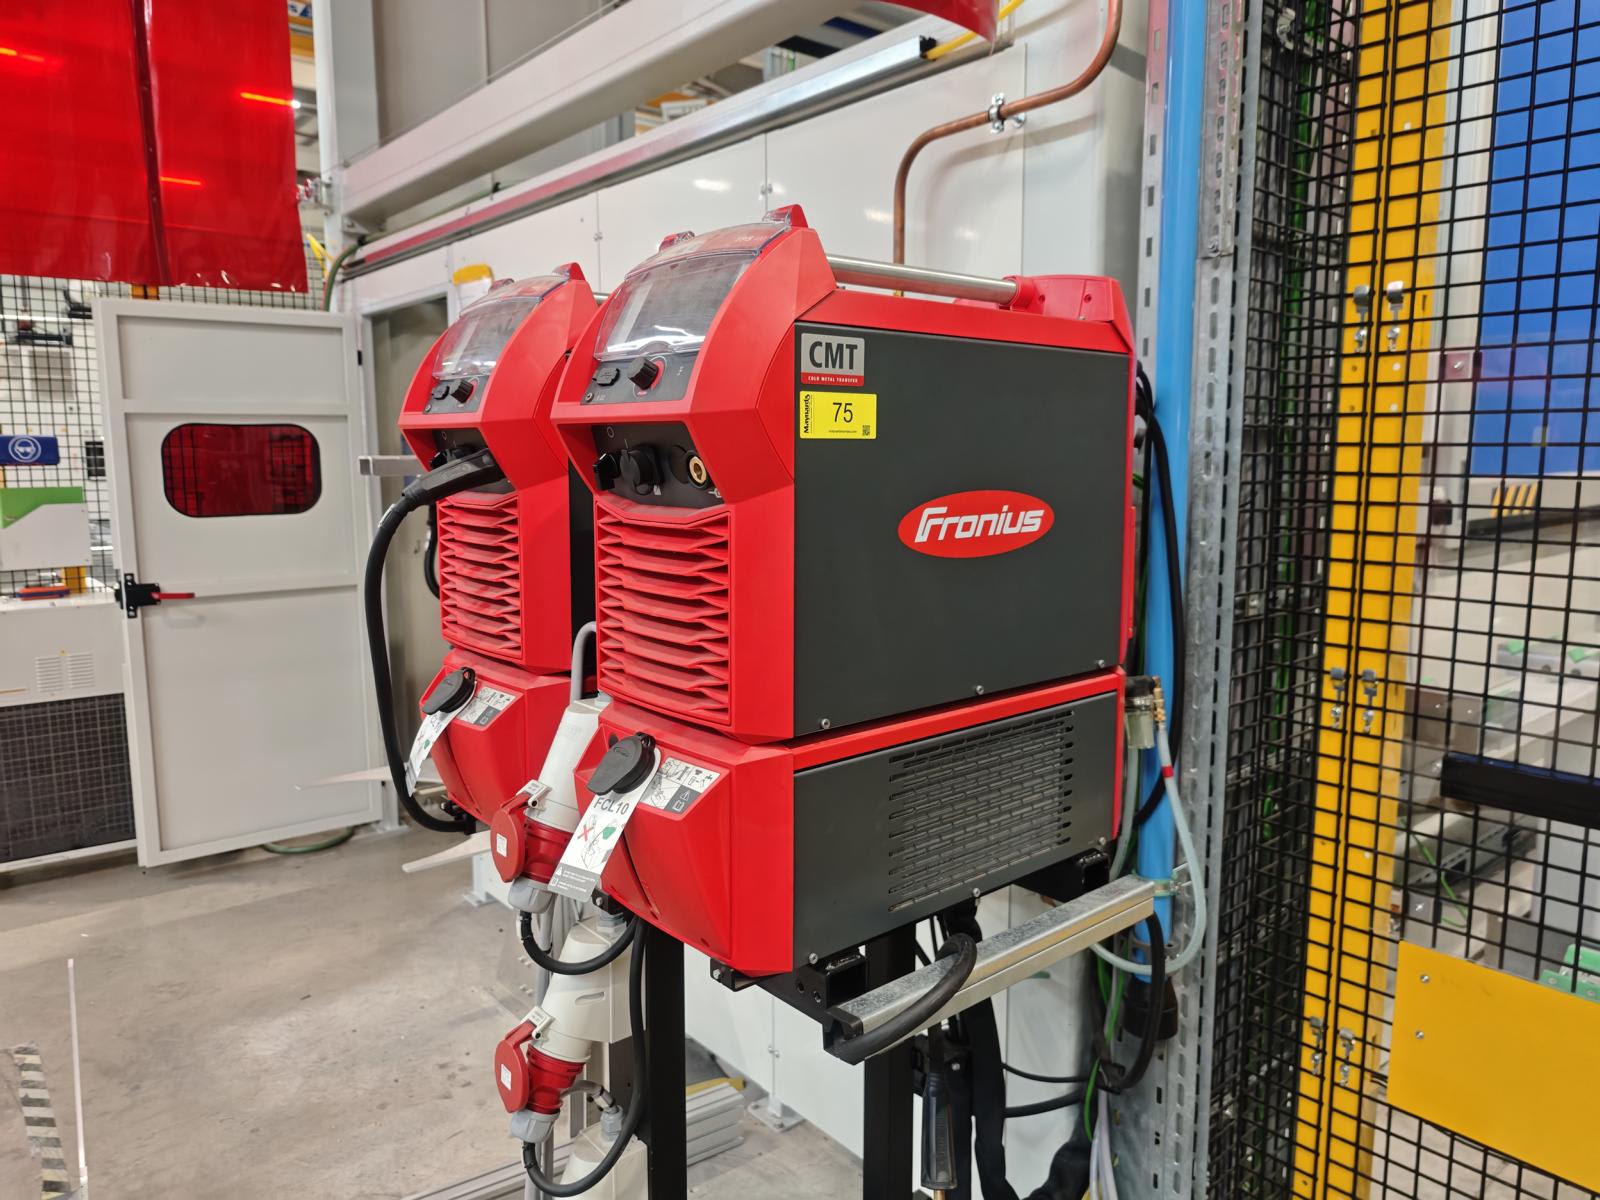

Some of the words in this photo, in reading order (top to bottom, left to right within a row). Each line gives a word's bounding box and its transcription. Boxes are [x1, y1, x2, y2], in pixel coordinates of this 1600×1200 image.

[809, 341, 858, 370] CMT
[832, 402, 853, 423] 75
[914, 505, 1045, 543] Fronius
[593, 796, 630, 815] FCL10
